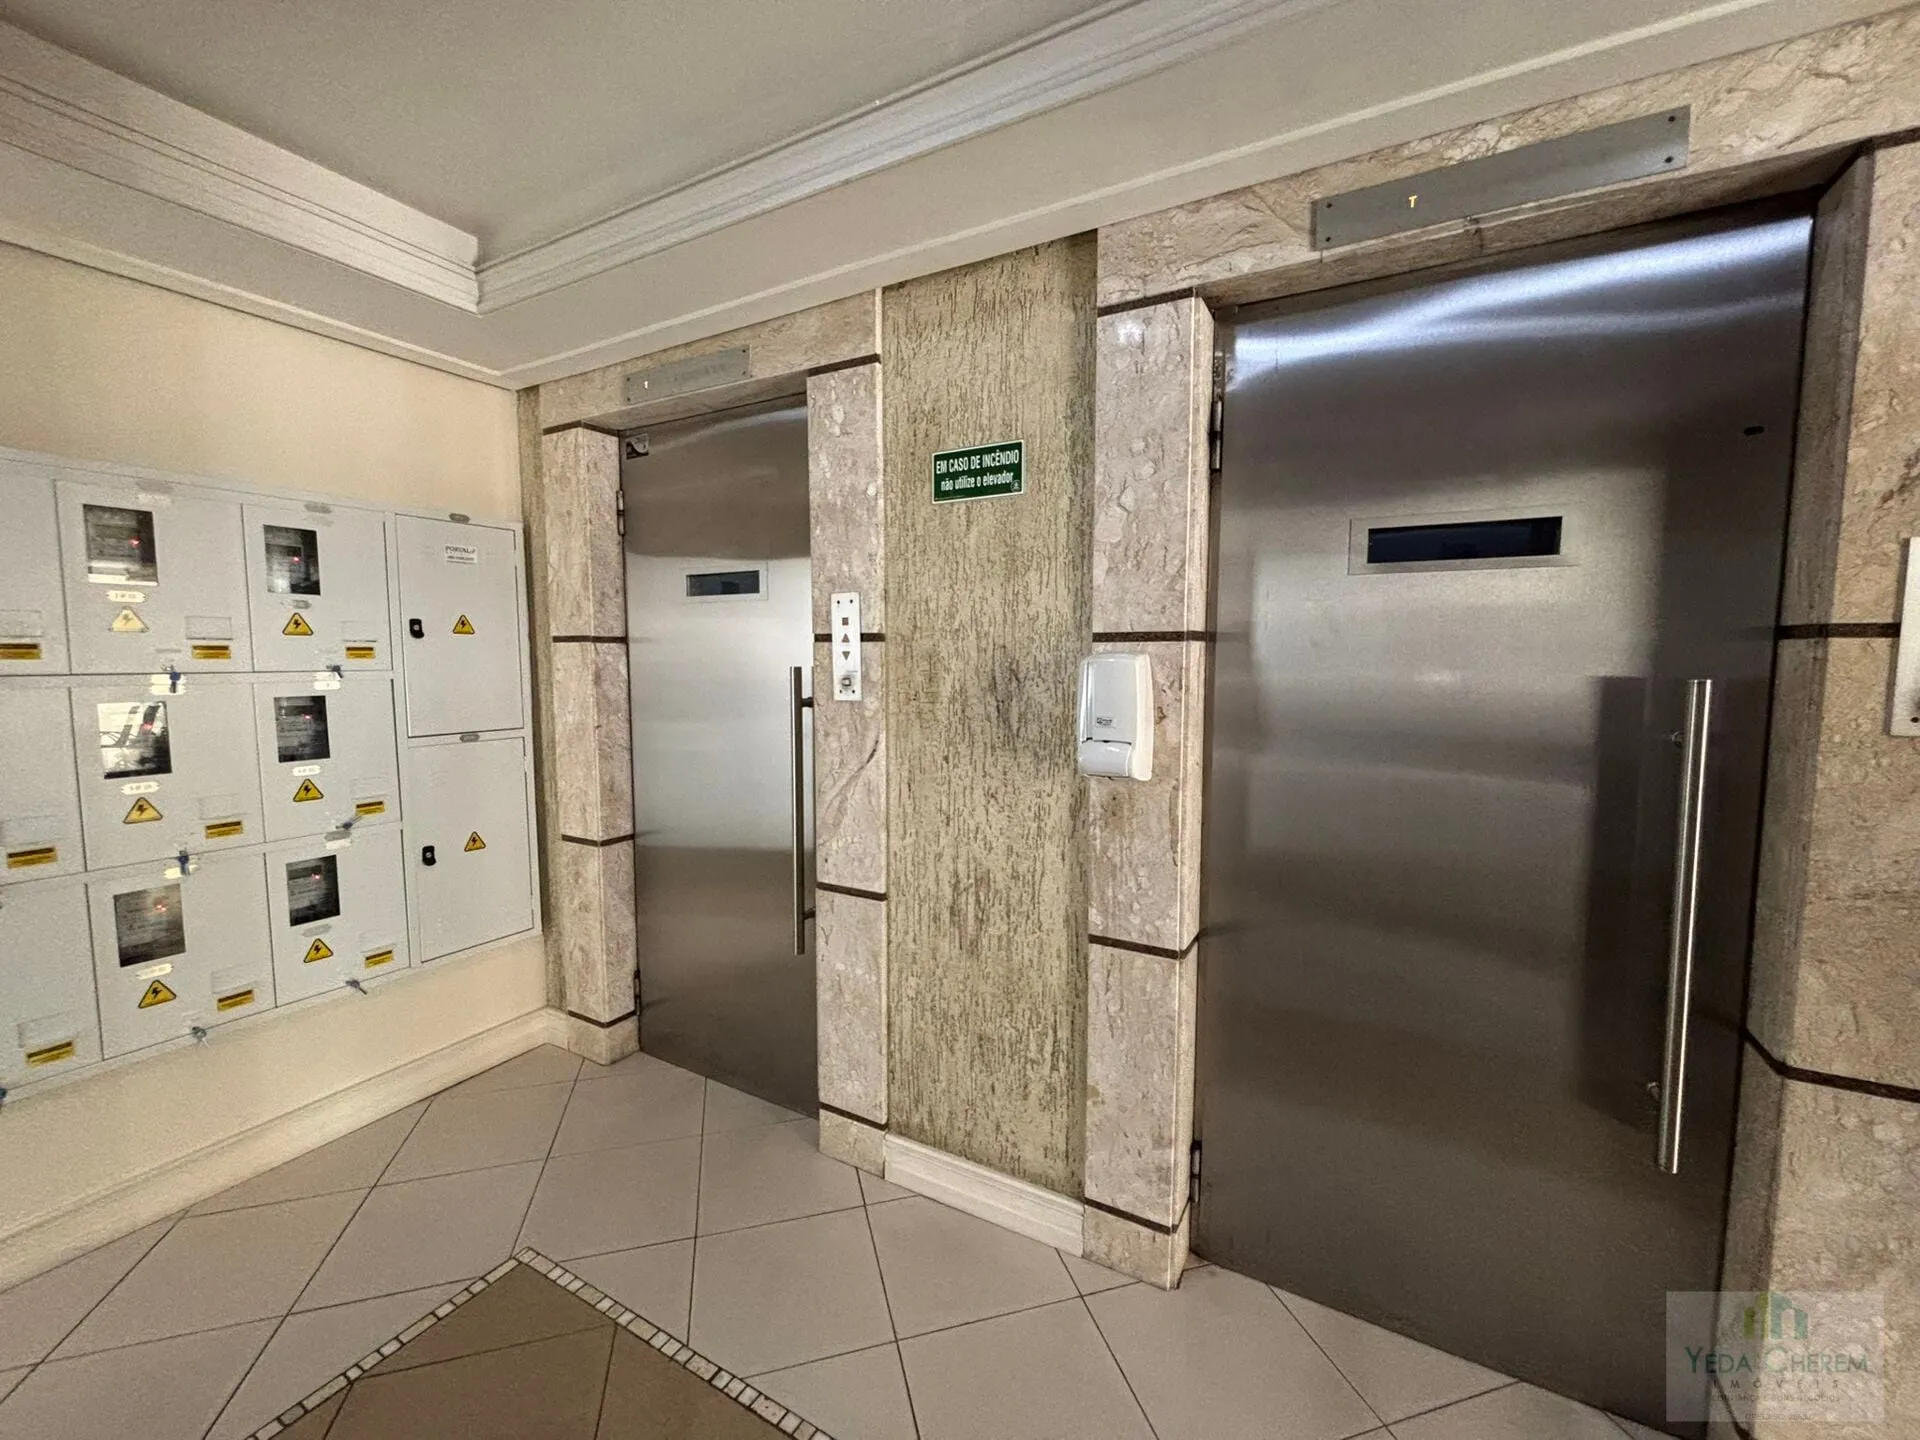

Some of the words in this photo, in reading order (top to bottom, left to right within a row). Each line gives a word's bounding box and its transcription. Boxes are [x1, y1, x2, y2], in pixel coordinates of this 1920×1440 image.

[1408, 195, 1418, 208] T
[936, 460, 947, 474] EM
[949, 456, 969, 473] CASO
[970, 455, 981, 470] DE
[982, 449, 1020, 468] INCÊNDIO
[940, 477, 954, 491] não
[954, 475, 975, 490] utilize
[977, 477, 981, 487] o
[982, 470, 1014, 487] elevador
